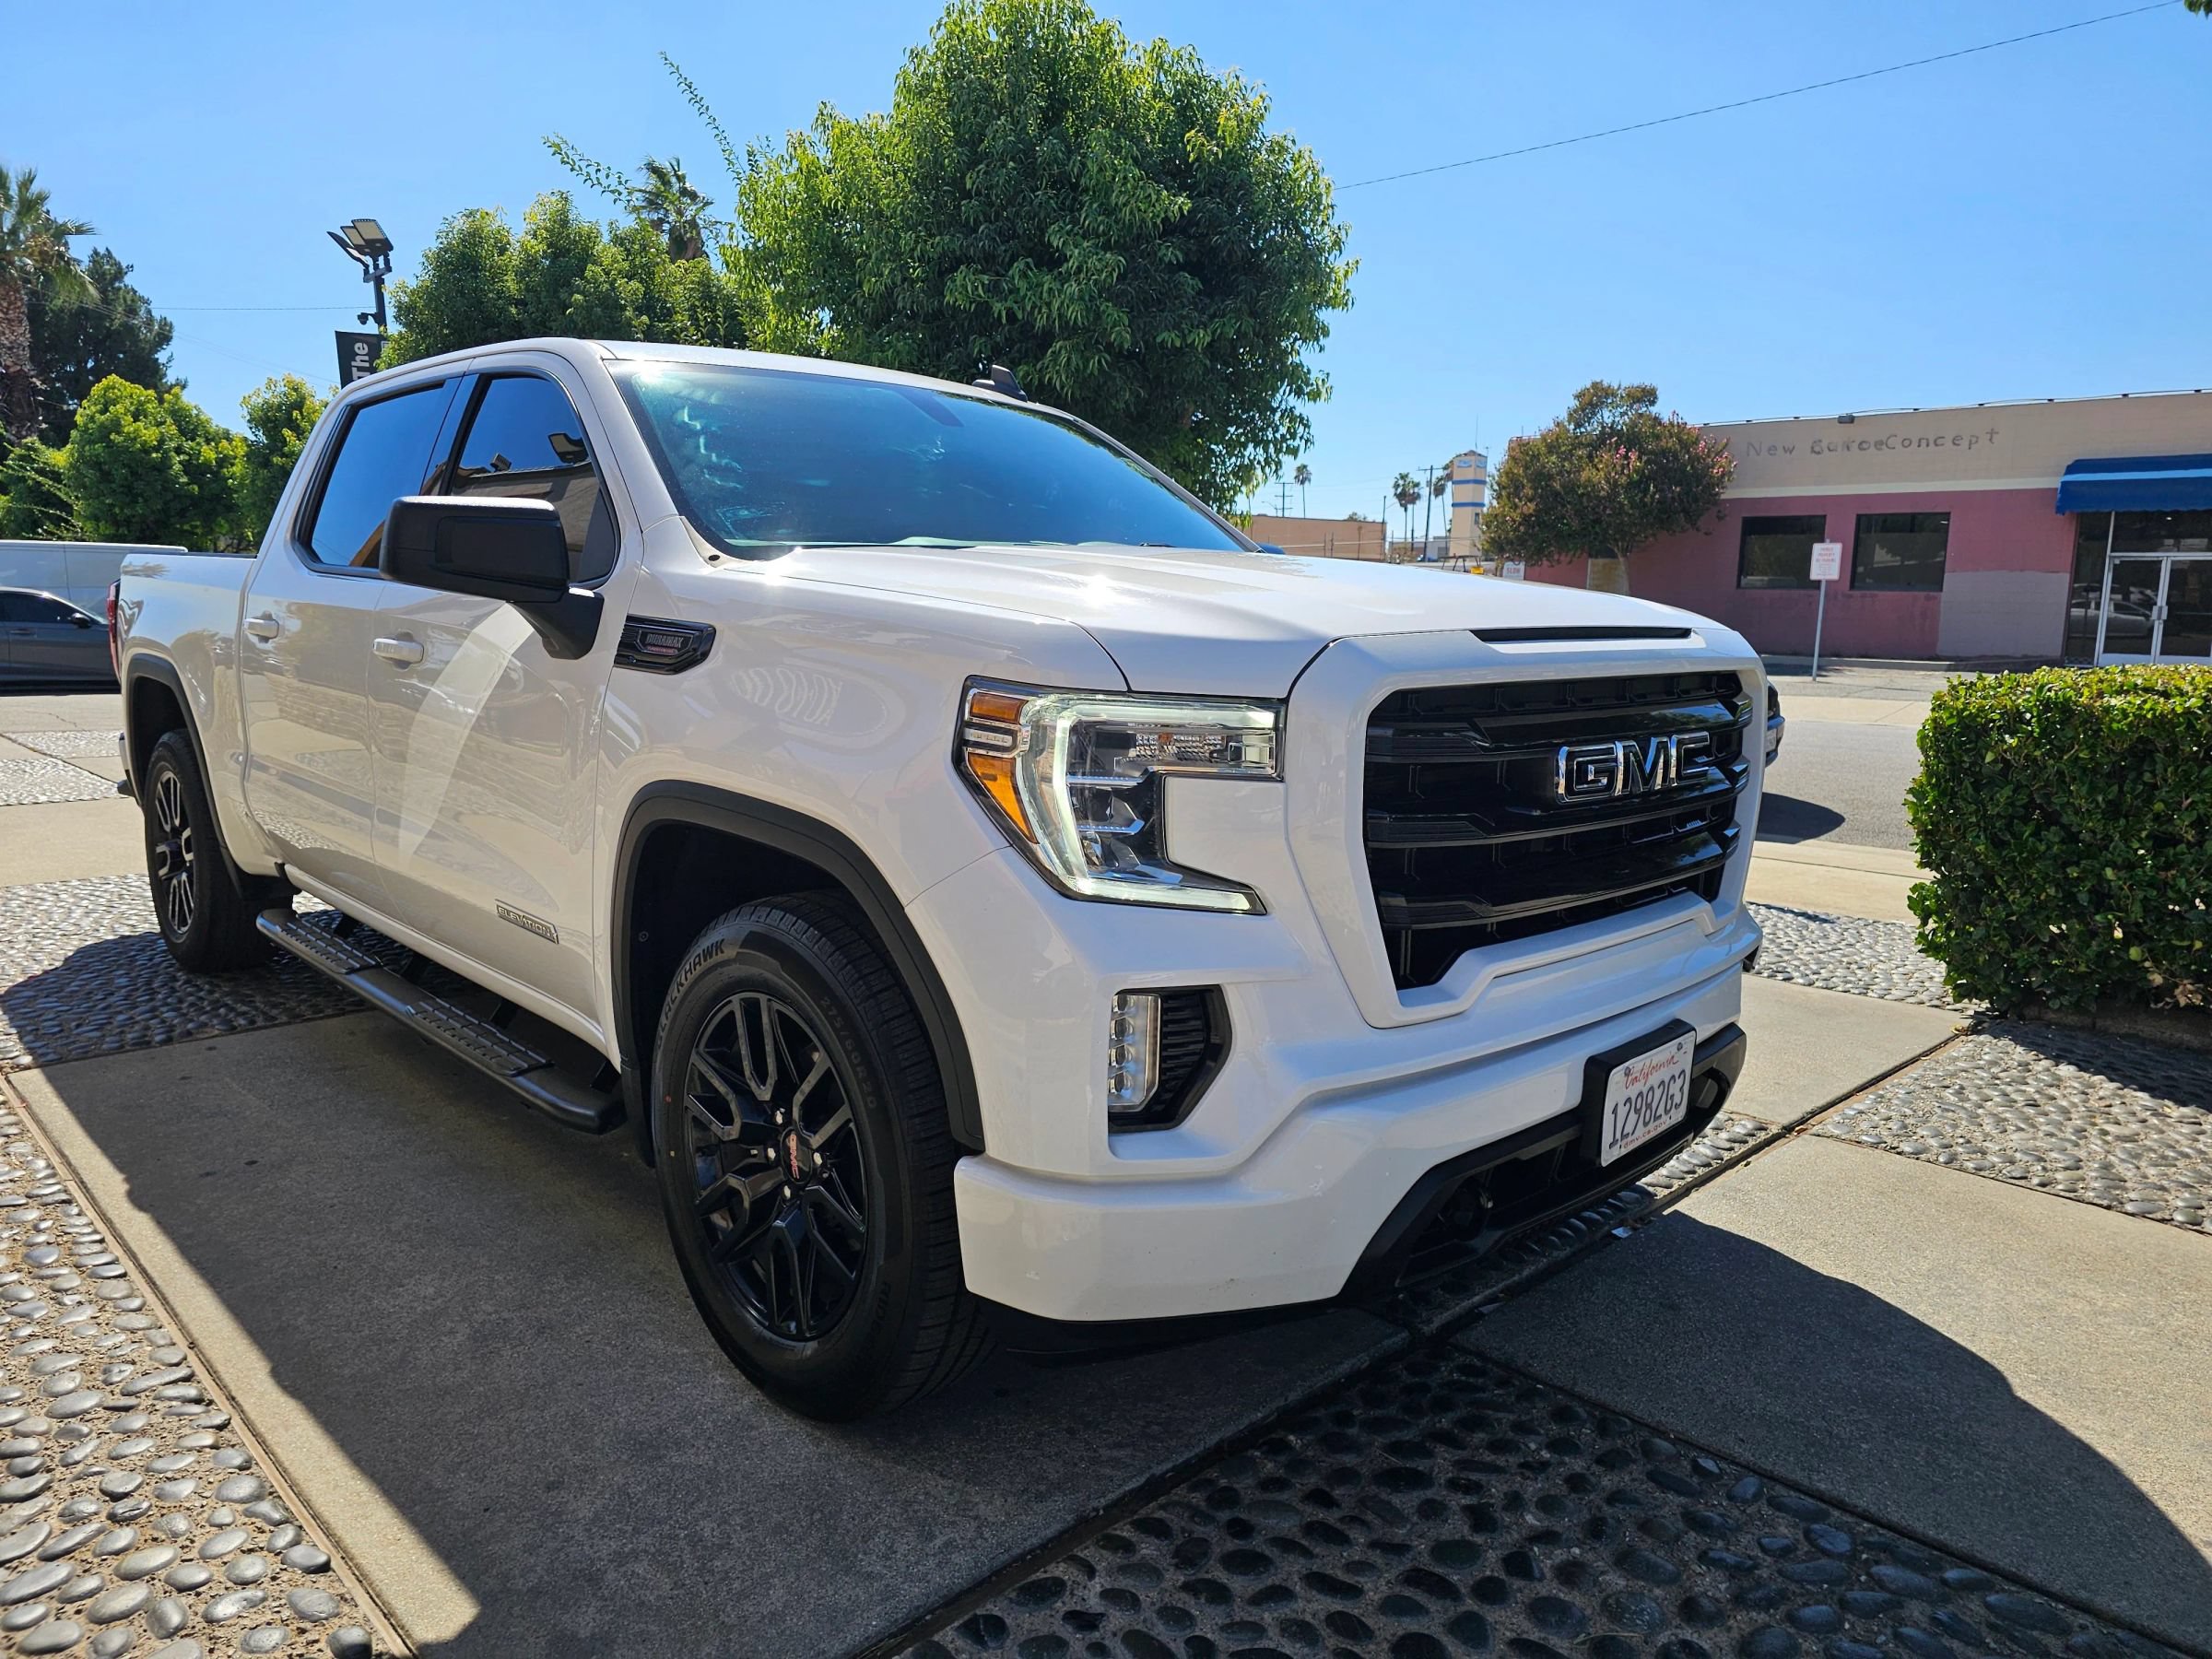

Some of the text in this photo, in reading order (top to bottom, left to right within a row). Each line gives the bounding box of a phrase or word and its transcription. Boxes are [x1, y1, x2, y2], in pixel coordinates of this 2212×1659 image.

[351, 342, 371, 381] The
[1746, 441, 1795, 457] New
[1554, 731, 1711, 805] GMC
[498, 907, 551, 937] ELEVATION
[1624, 1052, 1679, 1090] California
[1608, 1068, 1687, 1149] 12982G3
[1623, 1119, 1667, 1149] dmv.ca.gov
